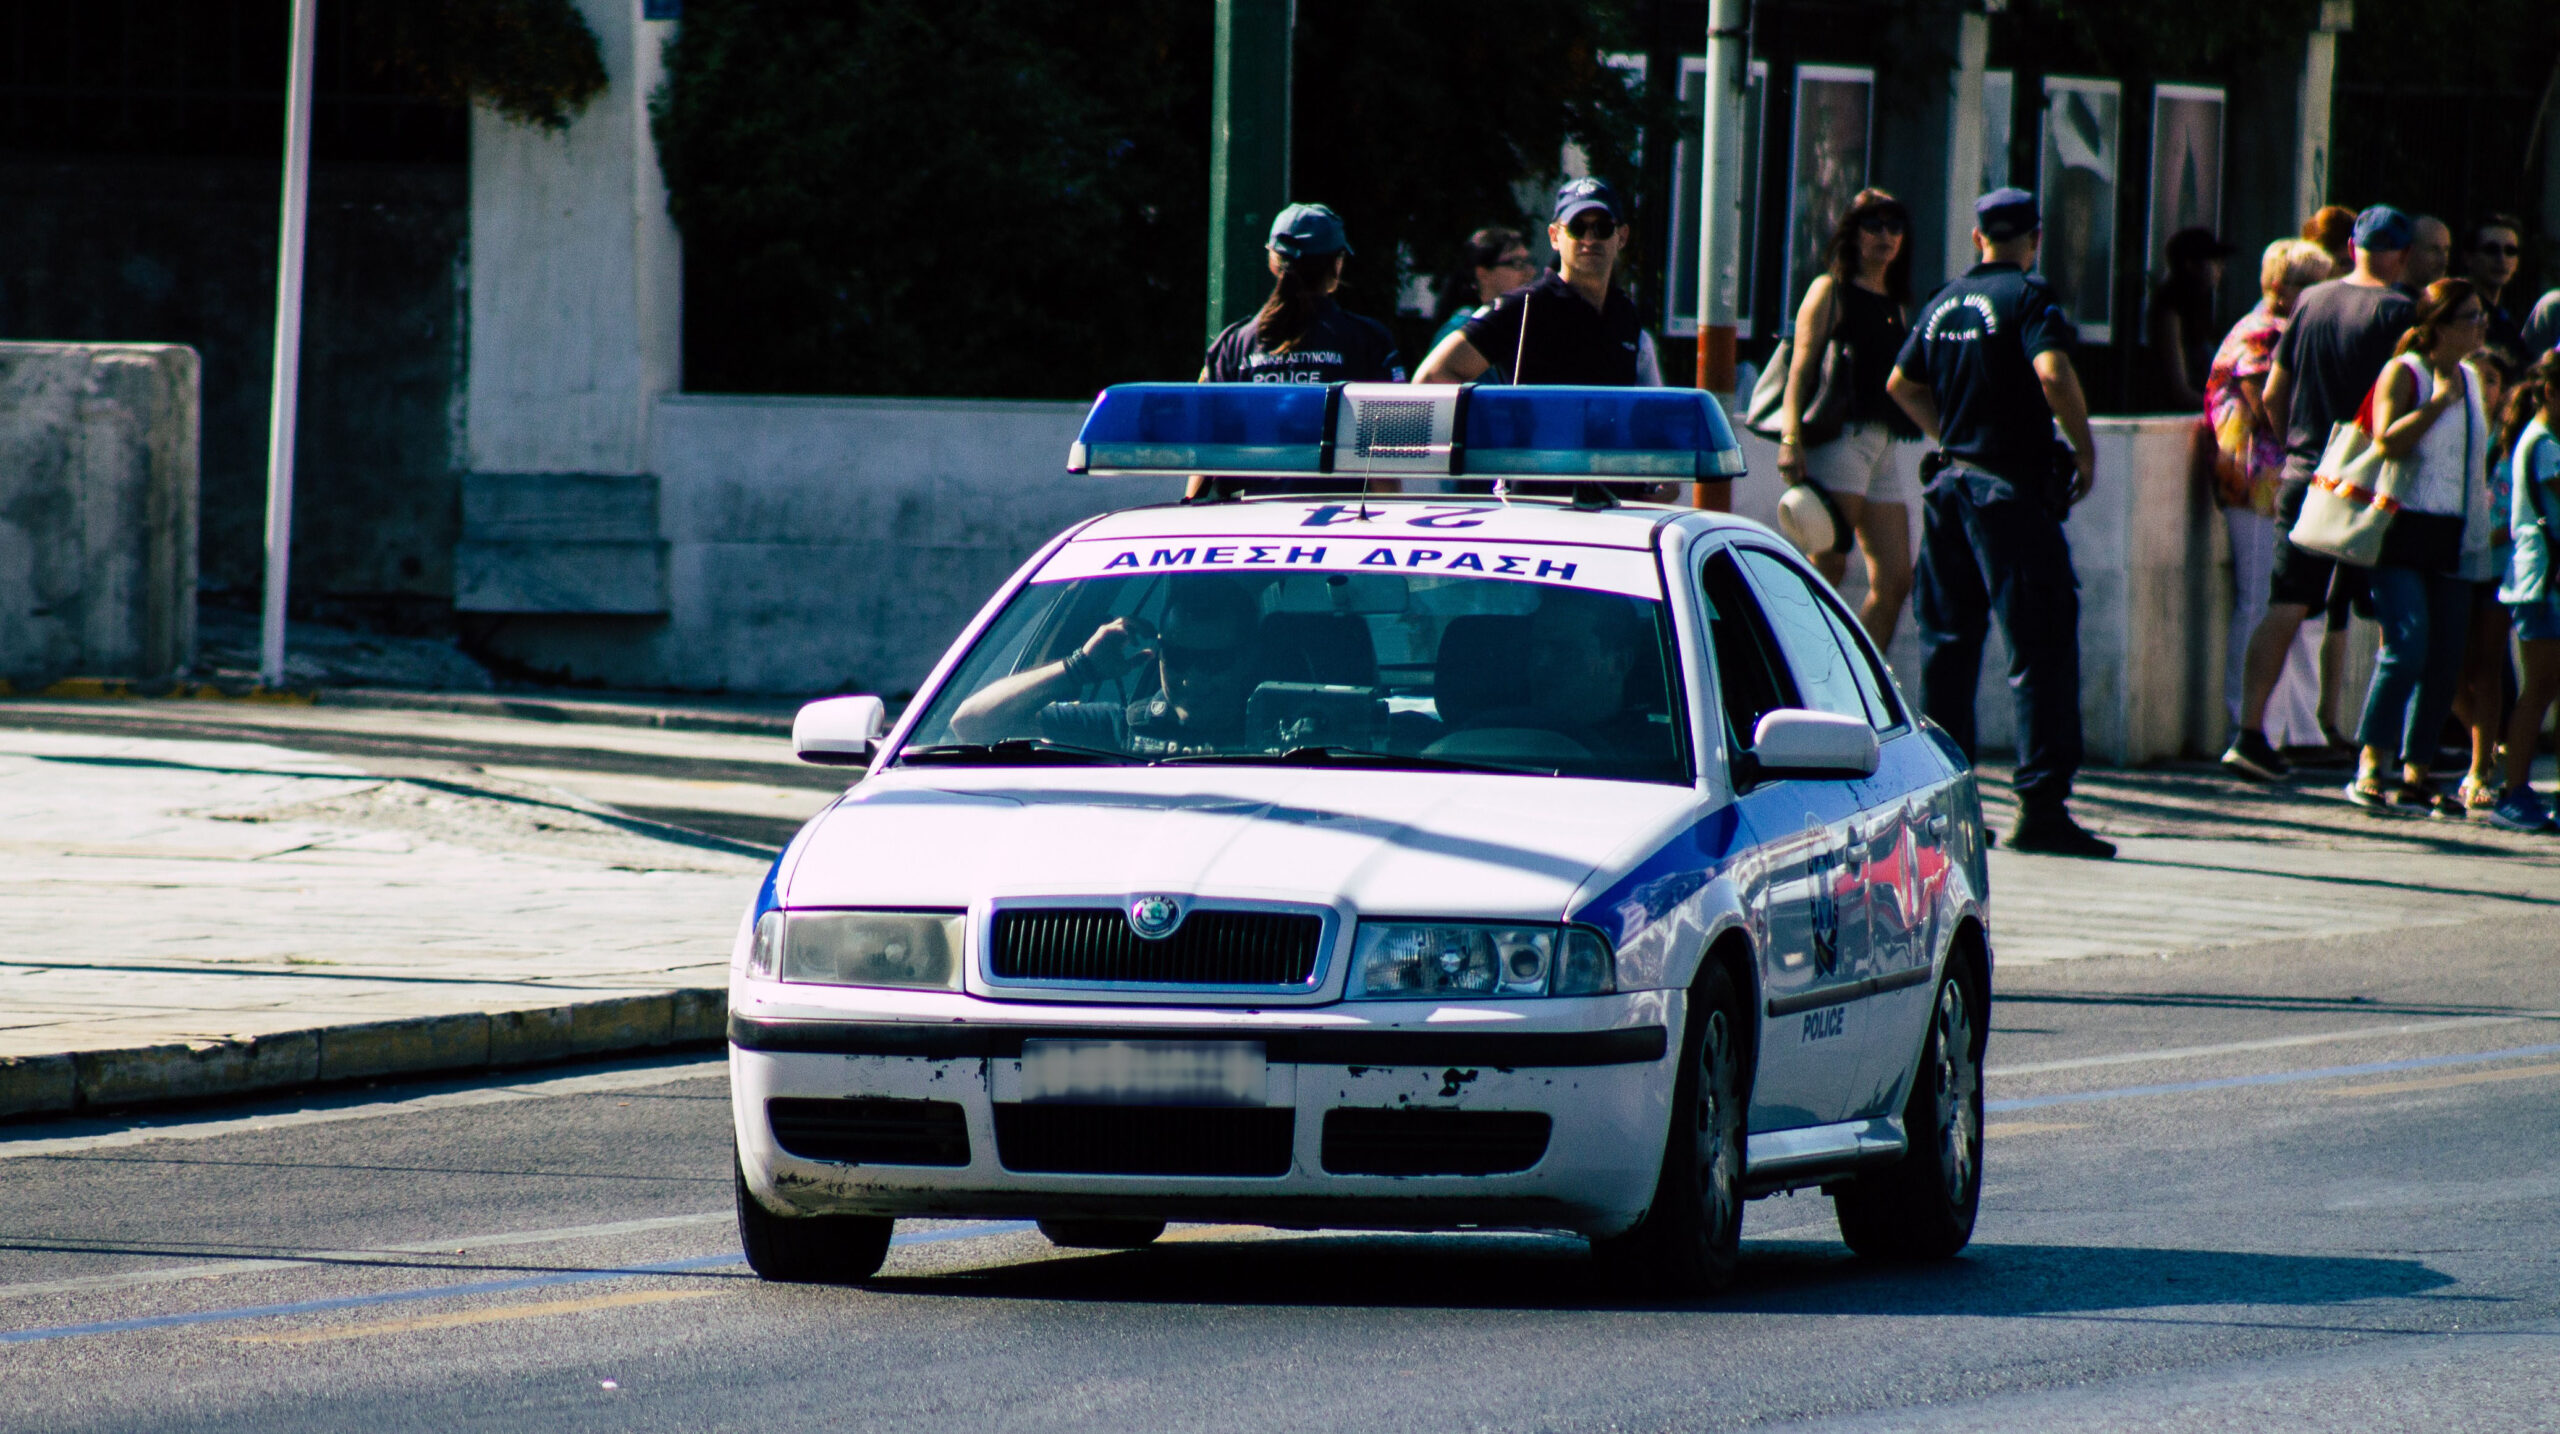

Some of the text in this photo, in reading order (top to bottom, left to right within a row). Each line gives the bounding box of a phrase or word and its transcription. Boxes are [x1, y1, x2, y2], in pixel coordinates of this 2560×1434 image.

[1102, 546, 1578, 581] ΑΜΕΣΗ ΔΡΑΣΗ
[1802, 1007, 1844, 1042] POLICE
